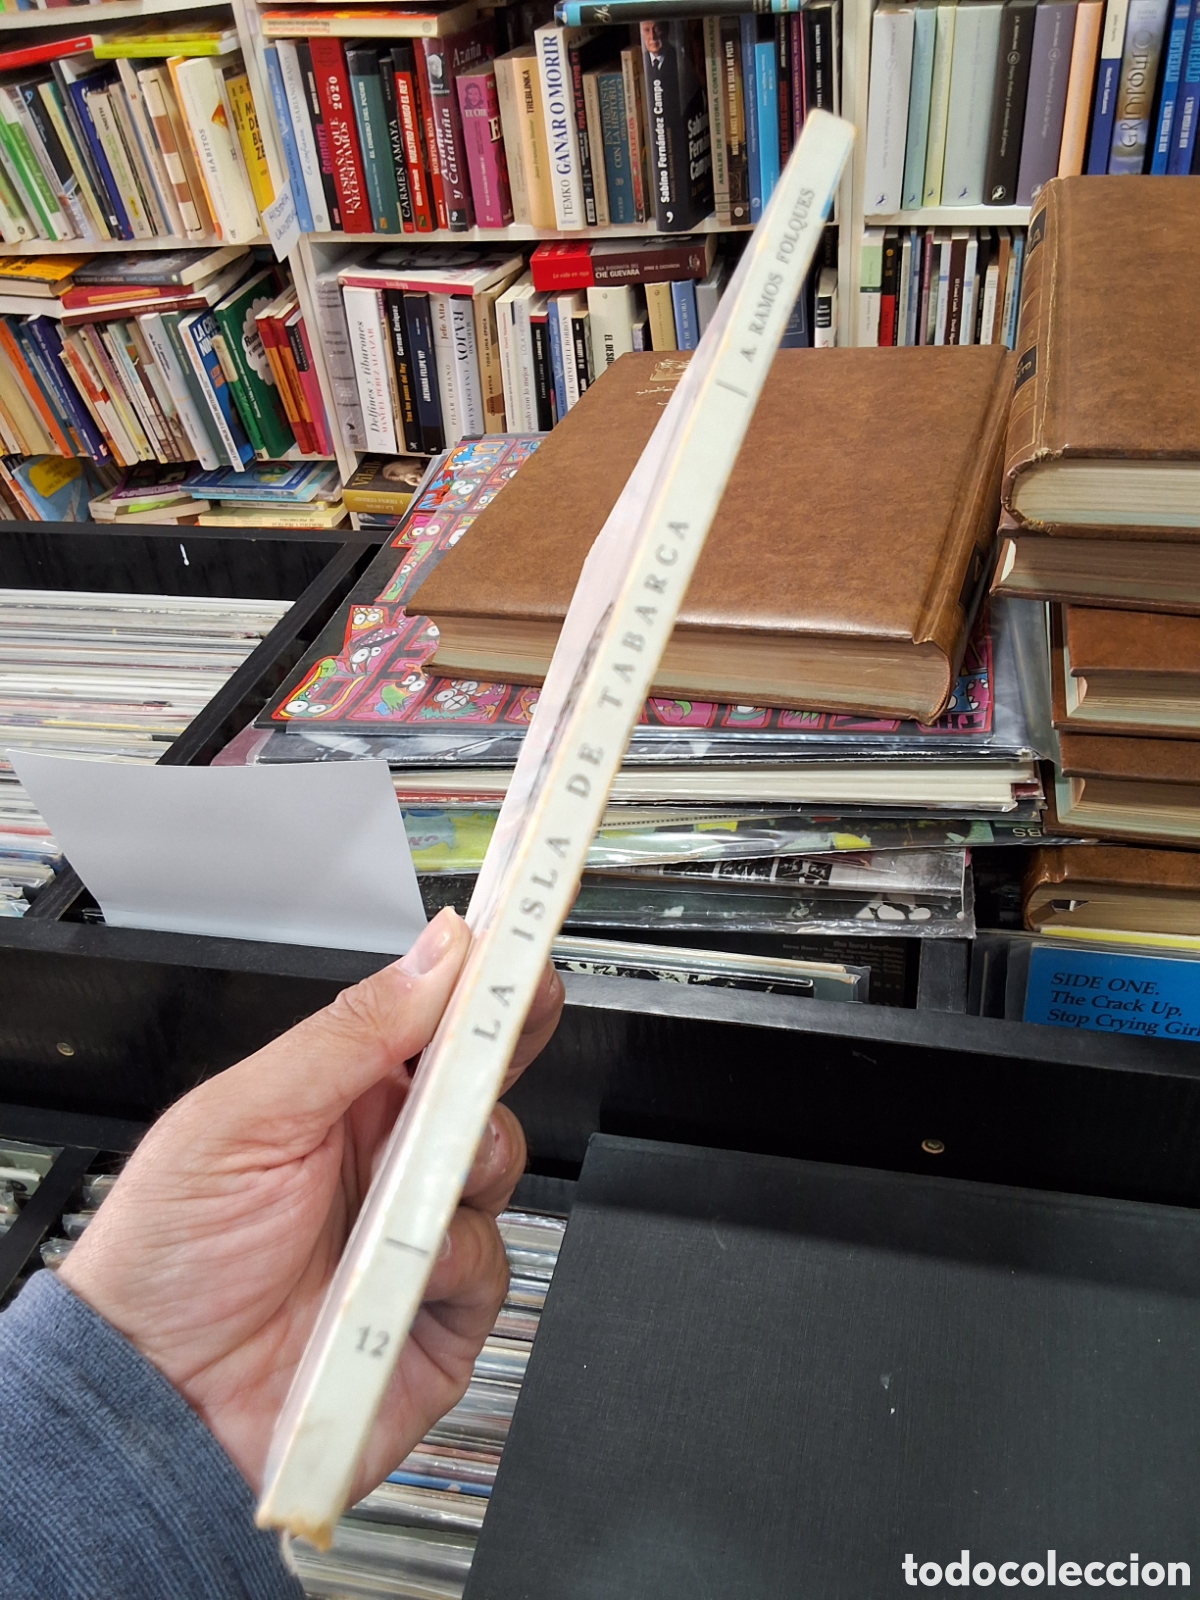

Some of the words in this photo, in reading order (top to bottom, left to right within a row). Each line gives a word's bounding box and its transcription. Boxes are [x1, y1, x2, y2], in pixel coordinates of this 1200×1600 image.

[725, 41, 733, 55] PISTA
[1166, 30, 1185, 82] OTHERLAND
[543, 35, 564, 99] MORIR
[726, 66, 735, 81] SILLA
[328, 76, 342, 110] 2020
[359, 82, 368, 106] PODER
[398, 79, 408, 94] REY
[522, 70, 534, 114] TREBLINKA
[653, 79, 663, 114] Campo
[289, 83, 302, 124] MARIANO
[402, 104, 413, 131] AMIGO
[550, 102, 565, 115] O
[601, 80, 612, 145] ENTREVISTA
[609, 79, 619, 128] HISTORIA
[713, 98, 721, 135] HISTORIA
[330, 117, 342, 145] QUE
[364, 122, 374, 150] DINERO
[390, 120, 403, 163] AMAYA
[426, 117, 434, 138] ROJA
[614, 131, 621, 146] LA
[198, 128, 217, 172] HÁBITOS
[370, 150, 376, 158] EL
[406, 131, 418, 164] NUESTRO
[442, 108, 459, 184] Cataluña
[552, 117, 571, 174] GANAR
[655, 117, 667, 168] Fernández
[717, 138, 722, 149] DE
[335, 148, 350, 195] ESPAÑA
[341, 122, 362, 210] NECESITAMOS
[396, 167, 411, 218] CARMEN
[453, 188, 464, 200] y
[560, 180, 574, 217] TEMKO
[659, 170, 670, 203] Sabino
[344, 198, 354, 214] LA
[595, 270, 608, 279] CHE
[609, 267, 640, 277] GUEVARA
[392, 305, 402, 331] Enríquez
[438, 303, 446, 317] Atta
[193, 324, 203, 342] LA
[396, 333, 405, 356] Carmen
[441, 320, 450, 341] Jefe
[466, 322, 474, 354] MARIANO
[561, 316, 570, 346] BORBÓN
[604, 334, 613, 342] EL
[357, 321, 370, 372] tiburones
[418, 350, 426, 360] VI?
[400, 363, 408, 374] Rey
[419, 361, 429, 378] FELIPE
[453, 311, 469, 362] RAJOY
[465, 388, 474, 416] ESPAÑA
[521, 365, 529, 386] mejor
[376, 369, 384, 398] PÉREZ
[422, 378, 432, 402] ¿REINARÁ
[446, 365, 455, 397] URBANO
[365, 382, 380, 432] Delfines
[379, 401, 388, 434] MANUEL
[354, 1326, 390, 1359] 12
[472, 982, 516, 1042] LA
[512, 836, 571, 942] ISLA
[567, 742, 605, 798] DE
[599, 520, 689, 709] TABARCA
[750, 272, 784, 336] RAMOS
[776, 188, 815, 265] FOLQUES
[1051, 972, 1104, 990] SIDE
[1108, 978, 1160, 995] ONE.
[1051, 990, 1086, 1006] The
[1092, 995, 1146, 1012] Crack
[1151, 1001, 1182, 1019] Up.
[1047, 1008, 1090, 1028] Stop
[1095, 1014, 1160, 1035] Crying
